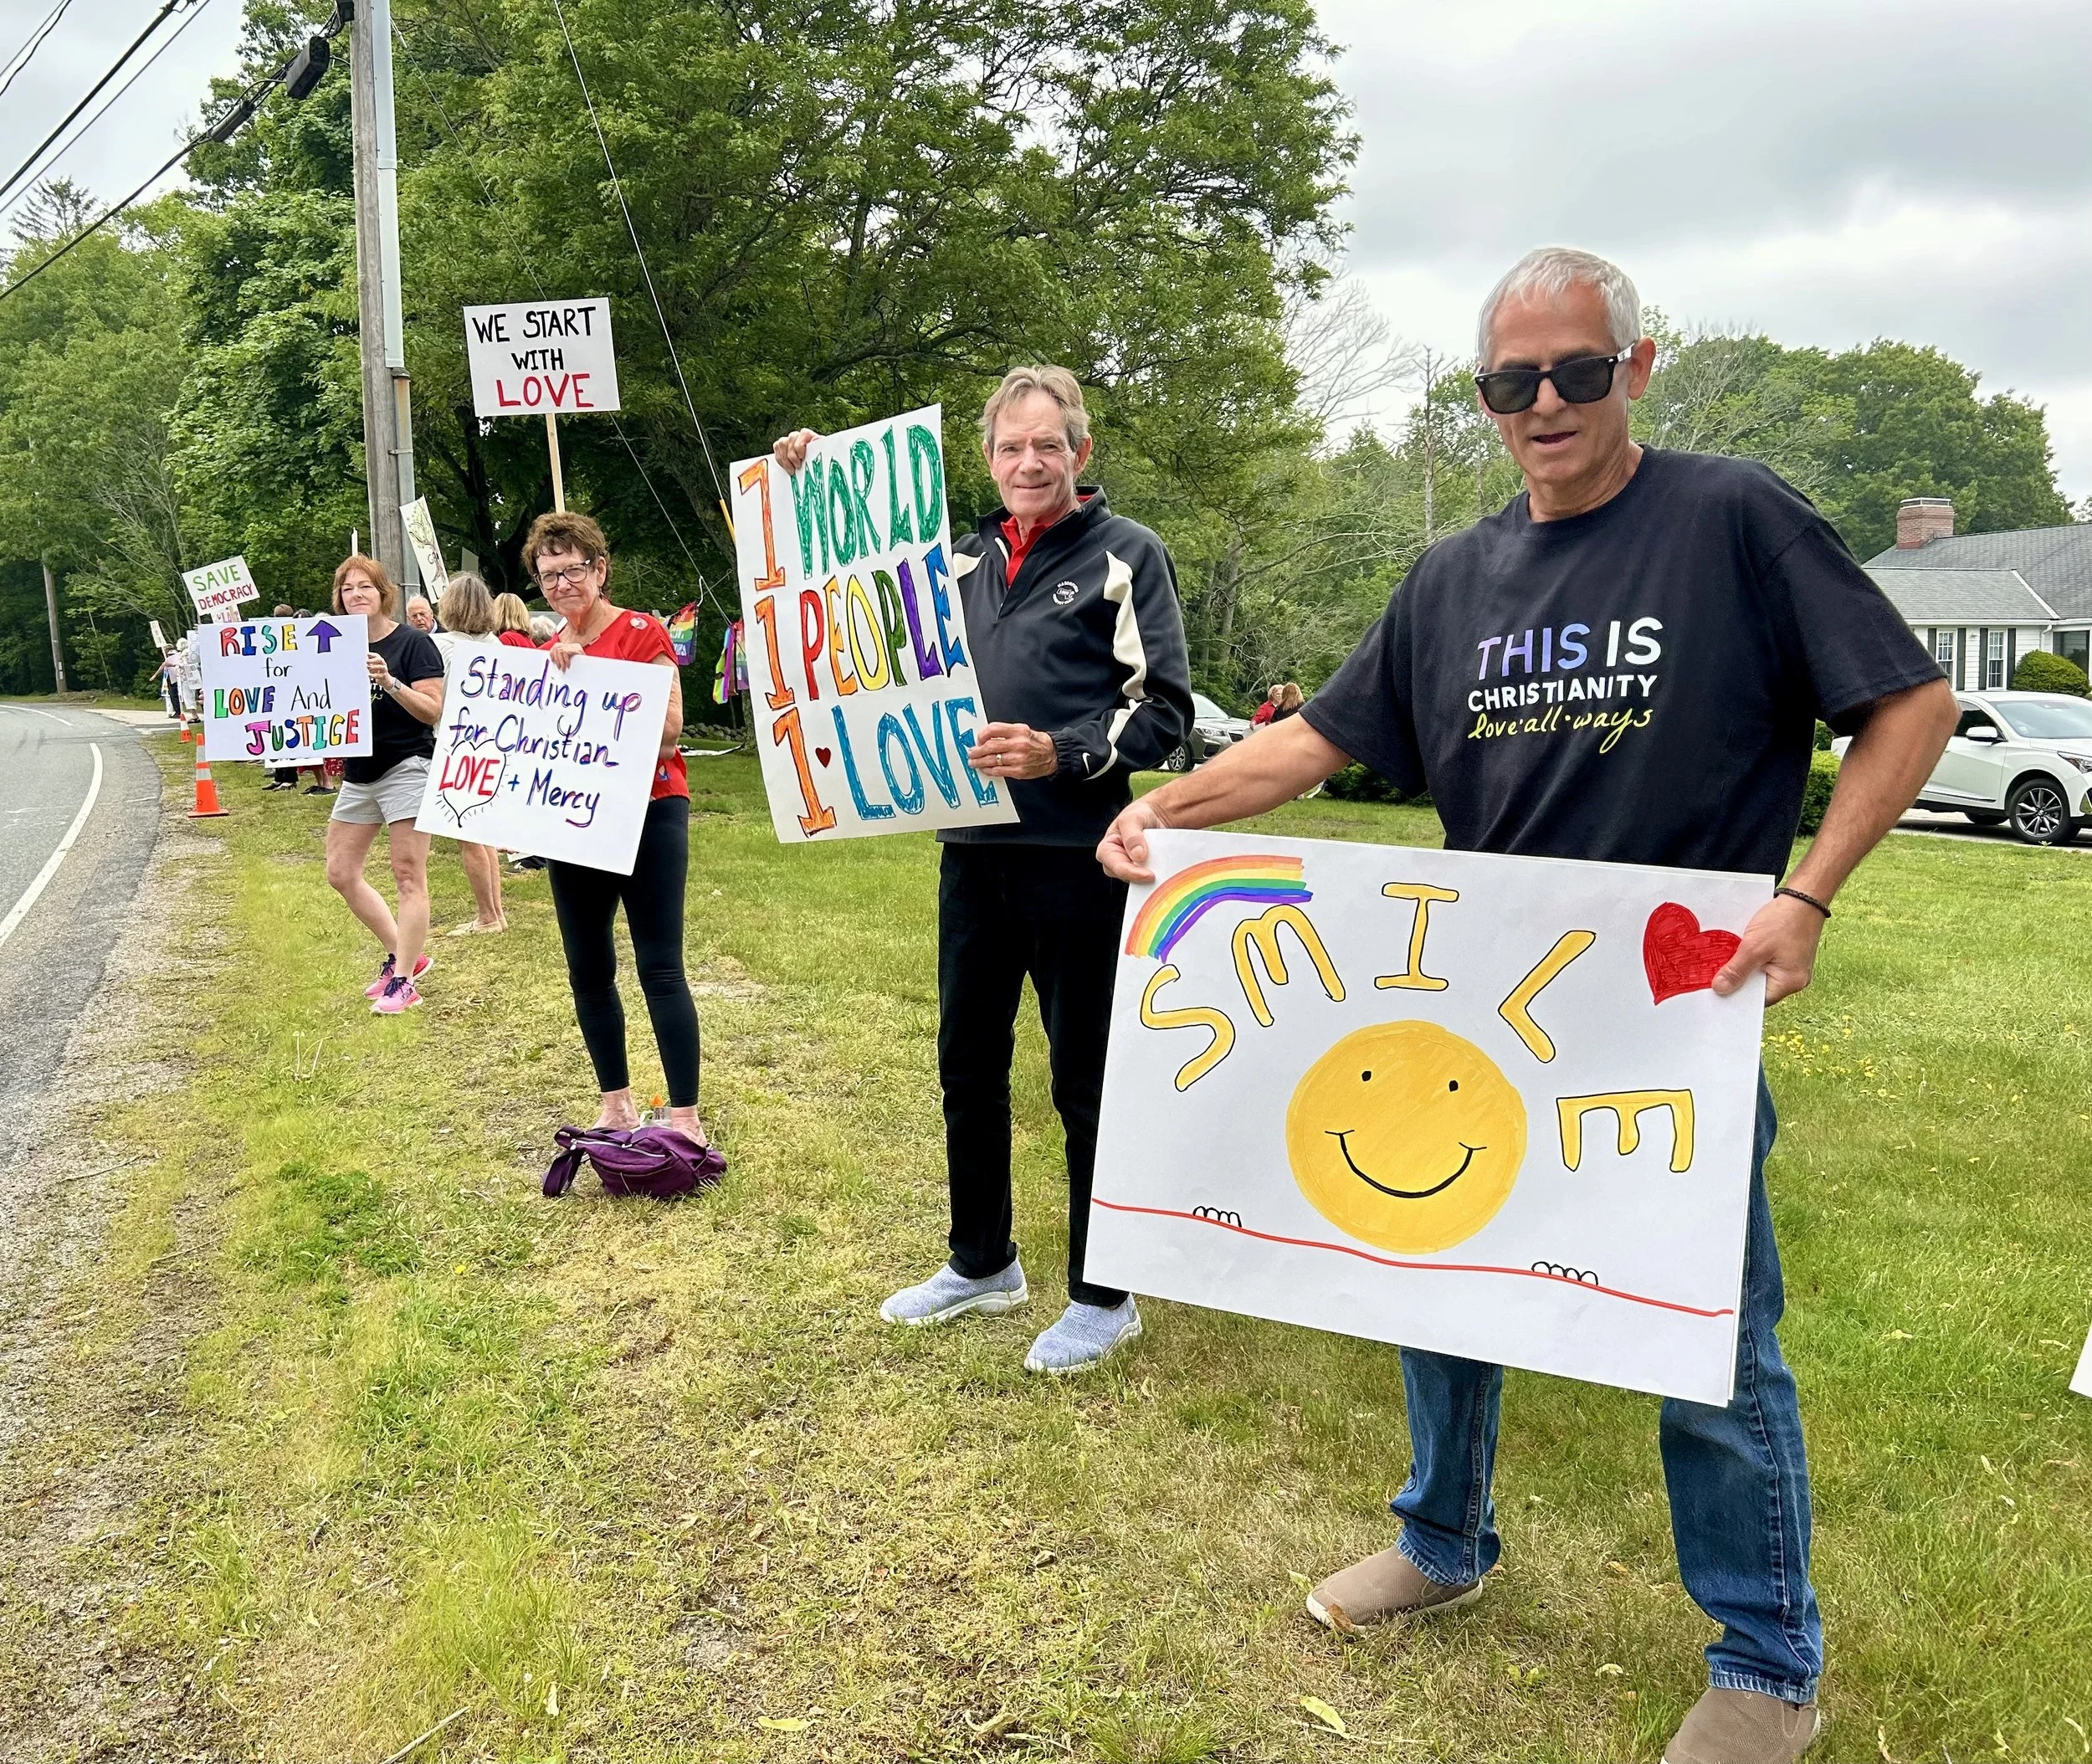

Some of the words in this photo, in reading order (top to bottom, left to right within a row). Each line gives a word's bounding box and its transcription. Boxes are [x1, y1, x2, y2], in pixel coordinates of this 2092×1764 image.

[472, 313, 510, 343] WE
[523, 306, 596, 338] START
[510, 347, 564, 371] WITH
[495, 373, 594, 408] LOVE
[738, 458, 786, 591] 1
[791, 424, 943, 580] WORLD
[192, 564, 241, 592] SAVE
[197, 583, 253, 611] DEMOCRACY
[219, 624, 298, 657] RISE
[754, 594, 796, 710] 1
[799, 542, 968, 701] PEOPLE
[262, 657, 293, 679] for
[1477, 623, 1590, 680] THIS
[1606, 617, 1664, 667] IS
[214, 685, 275, 719] LOVE
[290, 678, 331, 711] And
[460, 655, 588, 736] Standing
[602, 691, 643, 741] up
[1468, 674, 1658, 712] CHRISTIANITY
[244, 710, 360, 756] JUSTICE
[449, 706, 488, 747] for
[495, 714, 619, 767] Christian
[772, 706, 837, 838] 1
[831, 696, 999, 822] LOVE
[438, 755, 500, 796] LOVE
[526, 767, 601, 828] Mercy
[1140, 882, 1695, 1172] SMILE
